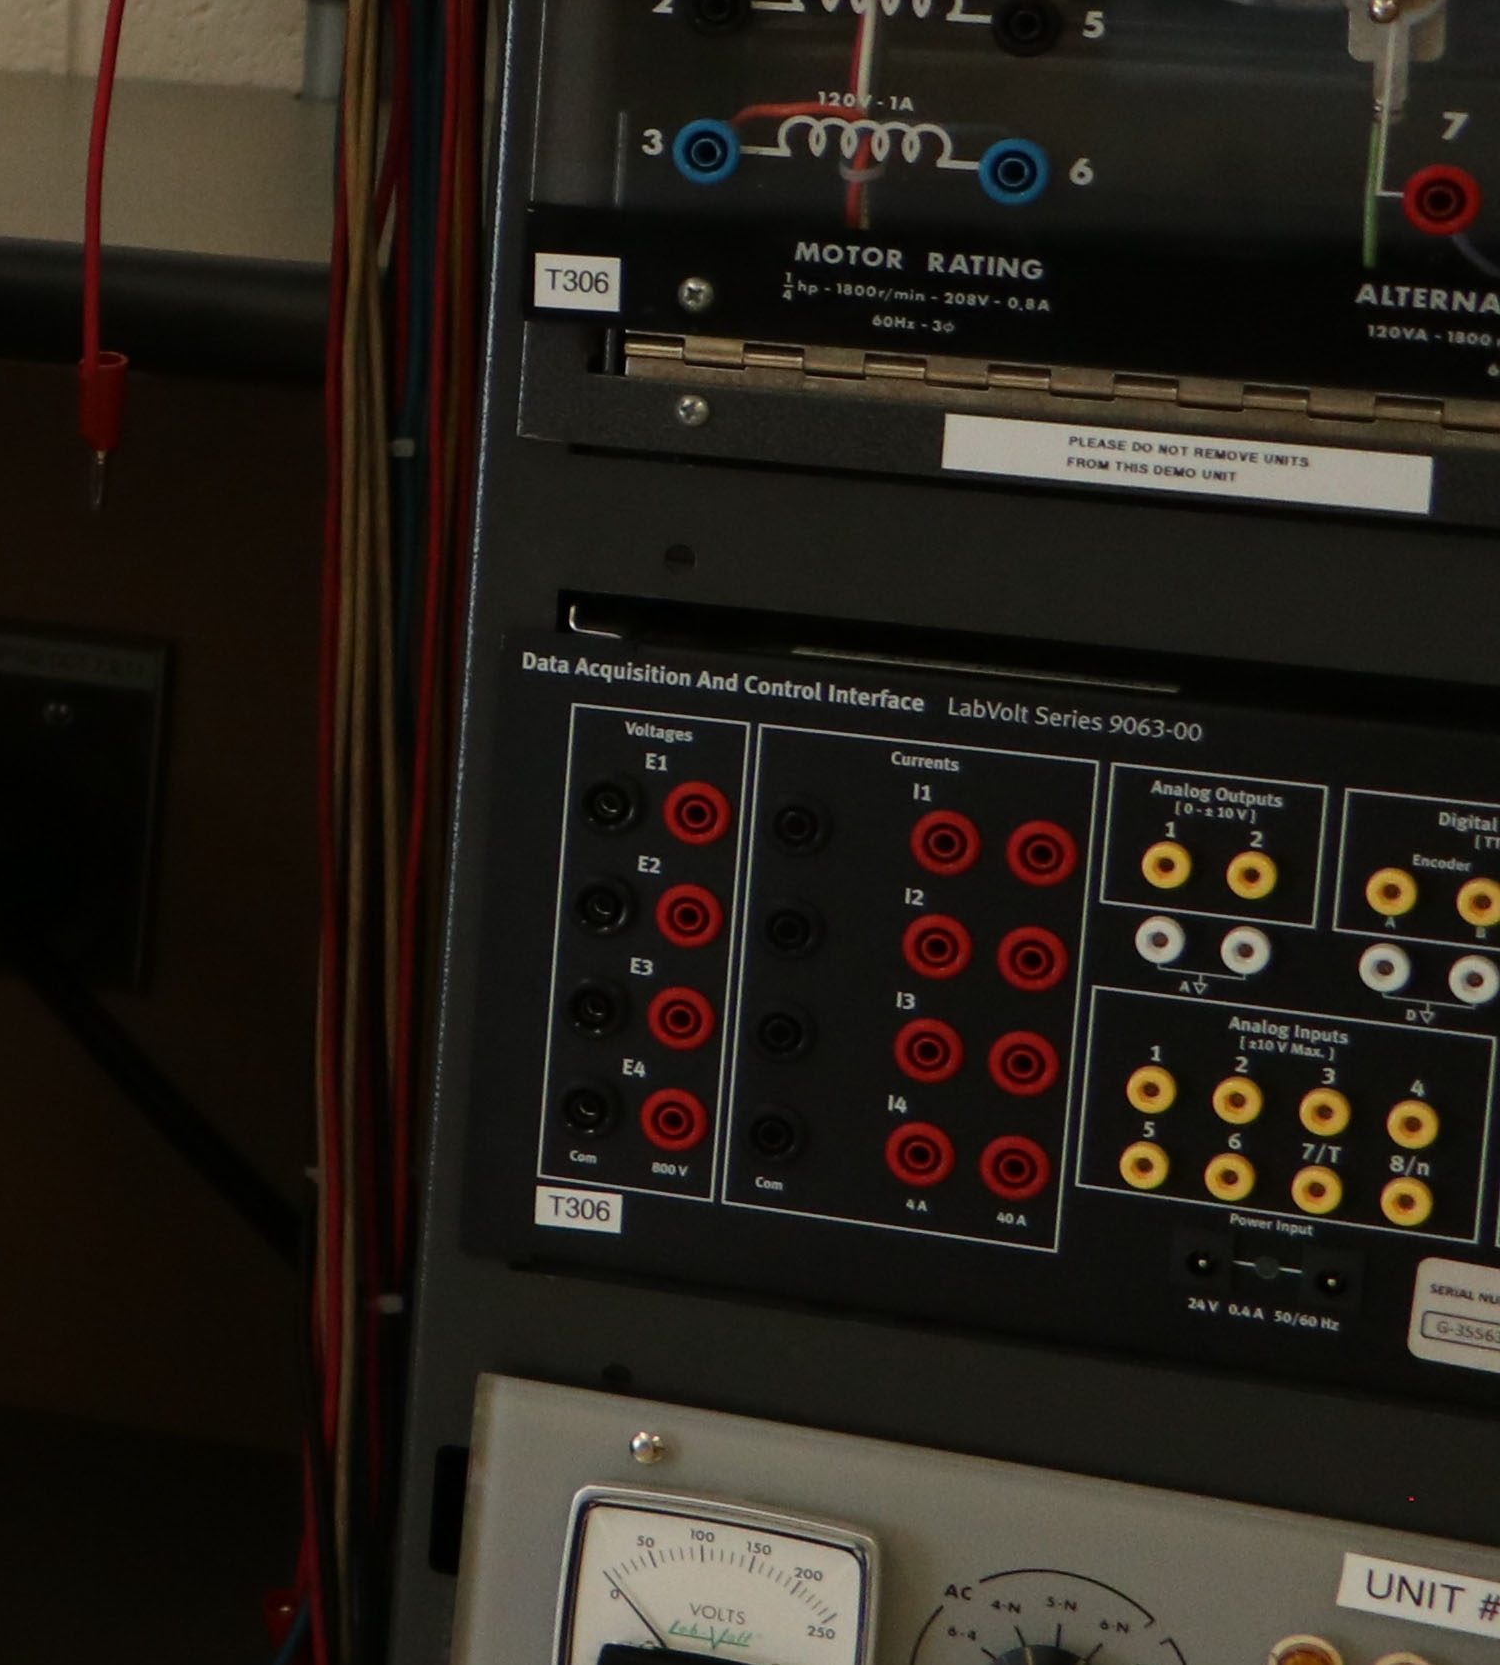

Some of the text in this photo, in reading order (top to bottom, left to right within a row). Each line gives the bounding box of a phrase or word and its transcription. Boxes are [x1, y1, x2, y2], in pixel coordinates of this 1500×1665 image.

[1082, 12, 1106, 39] 5
[818, 90, 914, 113] 120V 1A
[1440, 111, 1469, 141] 7
[642, 129, 664, 156] 3
[1068, 158, 1095, 186] 6
[795, 241, 1045, 281] MOTOR RATING
[545, 269, 610, 294] T306
[836, 281, 1050, 313] 1800r/min 208V 0.8A
[871, 313, 916, 330] 60Hz
[1367, 323, 1493, 347] 120VA 1800
[1069, 436, 1311, 468] PLEASE DO NOT REMOVE UNITS
[1067, 456, 1238, 484] FROM THIS DEMO UNIT
[521, 652, 1204, 743] Data Acquisition And Control Interface LabVolt Series 9063-00
[624, 721, 694, 744] Voltages
[645, 752, 668, 773] E1
[891, 750, 960, 773] Currents
[913, 782, 932, 804] I1
[1151, 779, 1284, 810] Analog Outputs
[1165, 822, 1176, 838] 1
[1438, 811, 1499, 833] Digital
[1249, 831, 1263, 848] 2
[638, 855, 661, 875] E2
[1412, 853, 1472, 873] Encoder
[904, 887, 924, 907] I2
[1384, 915, 1397, 930] A
[629, 957, 654, 977] E3
[896, 991, 916, 1011] I3
[1229, 1015, 1349, 1046] Analog Inputs
[1150, 1045, 1162, 1063] 1
[1291, 1043, 1326, 1059] Max.
[622, 1059, 647, 1078] E4
[1235, 1056, 1250, 1074] 2
[1322, 1068, 1336, 1085] 3
[1411, 1080, 1426, 1098] 4
[887, 1094, 908, 1115] I4
[1143, 1120, 1156, 1138] 5
[1228, 1133, 1242, 1151] 6
[569, 1149, 597, 1166] Com
[1302, 1143, 1343, 1164] 7/T
[652, 1161, 689, 1178] 800 V
[1389, 1155, 1431, 1178] 8/n
[755, 1175, 784, 1192] Com
[548, 1194, 612, 1223] T306
[915, 1198, 928, 1213] A
[996, 1210, 1027, 1227] 40 A
[1229, 1212, 1315, 1238] Power Input
[1429, 1283, 1474, 1301] SERIAL
[1187, 1297, 1341, 1333] 24 V 0.4 A 50/60 Hz
[636, 1536, 655, 1549] 50
[690, 1529, 715, 1543] 100
[747, 1541, 772, 1556] 150
[793, 1567, 824, 1583] 200
[944, 1584, 973, 1601] AC
[1366, 1568, 1466, 1613] UNIT
[689, 1603, 746, 1626] VOLTS
[808, 1625, 836, 1640] 250
